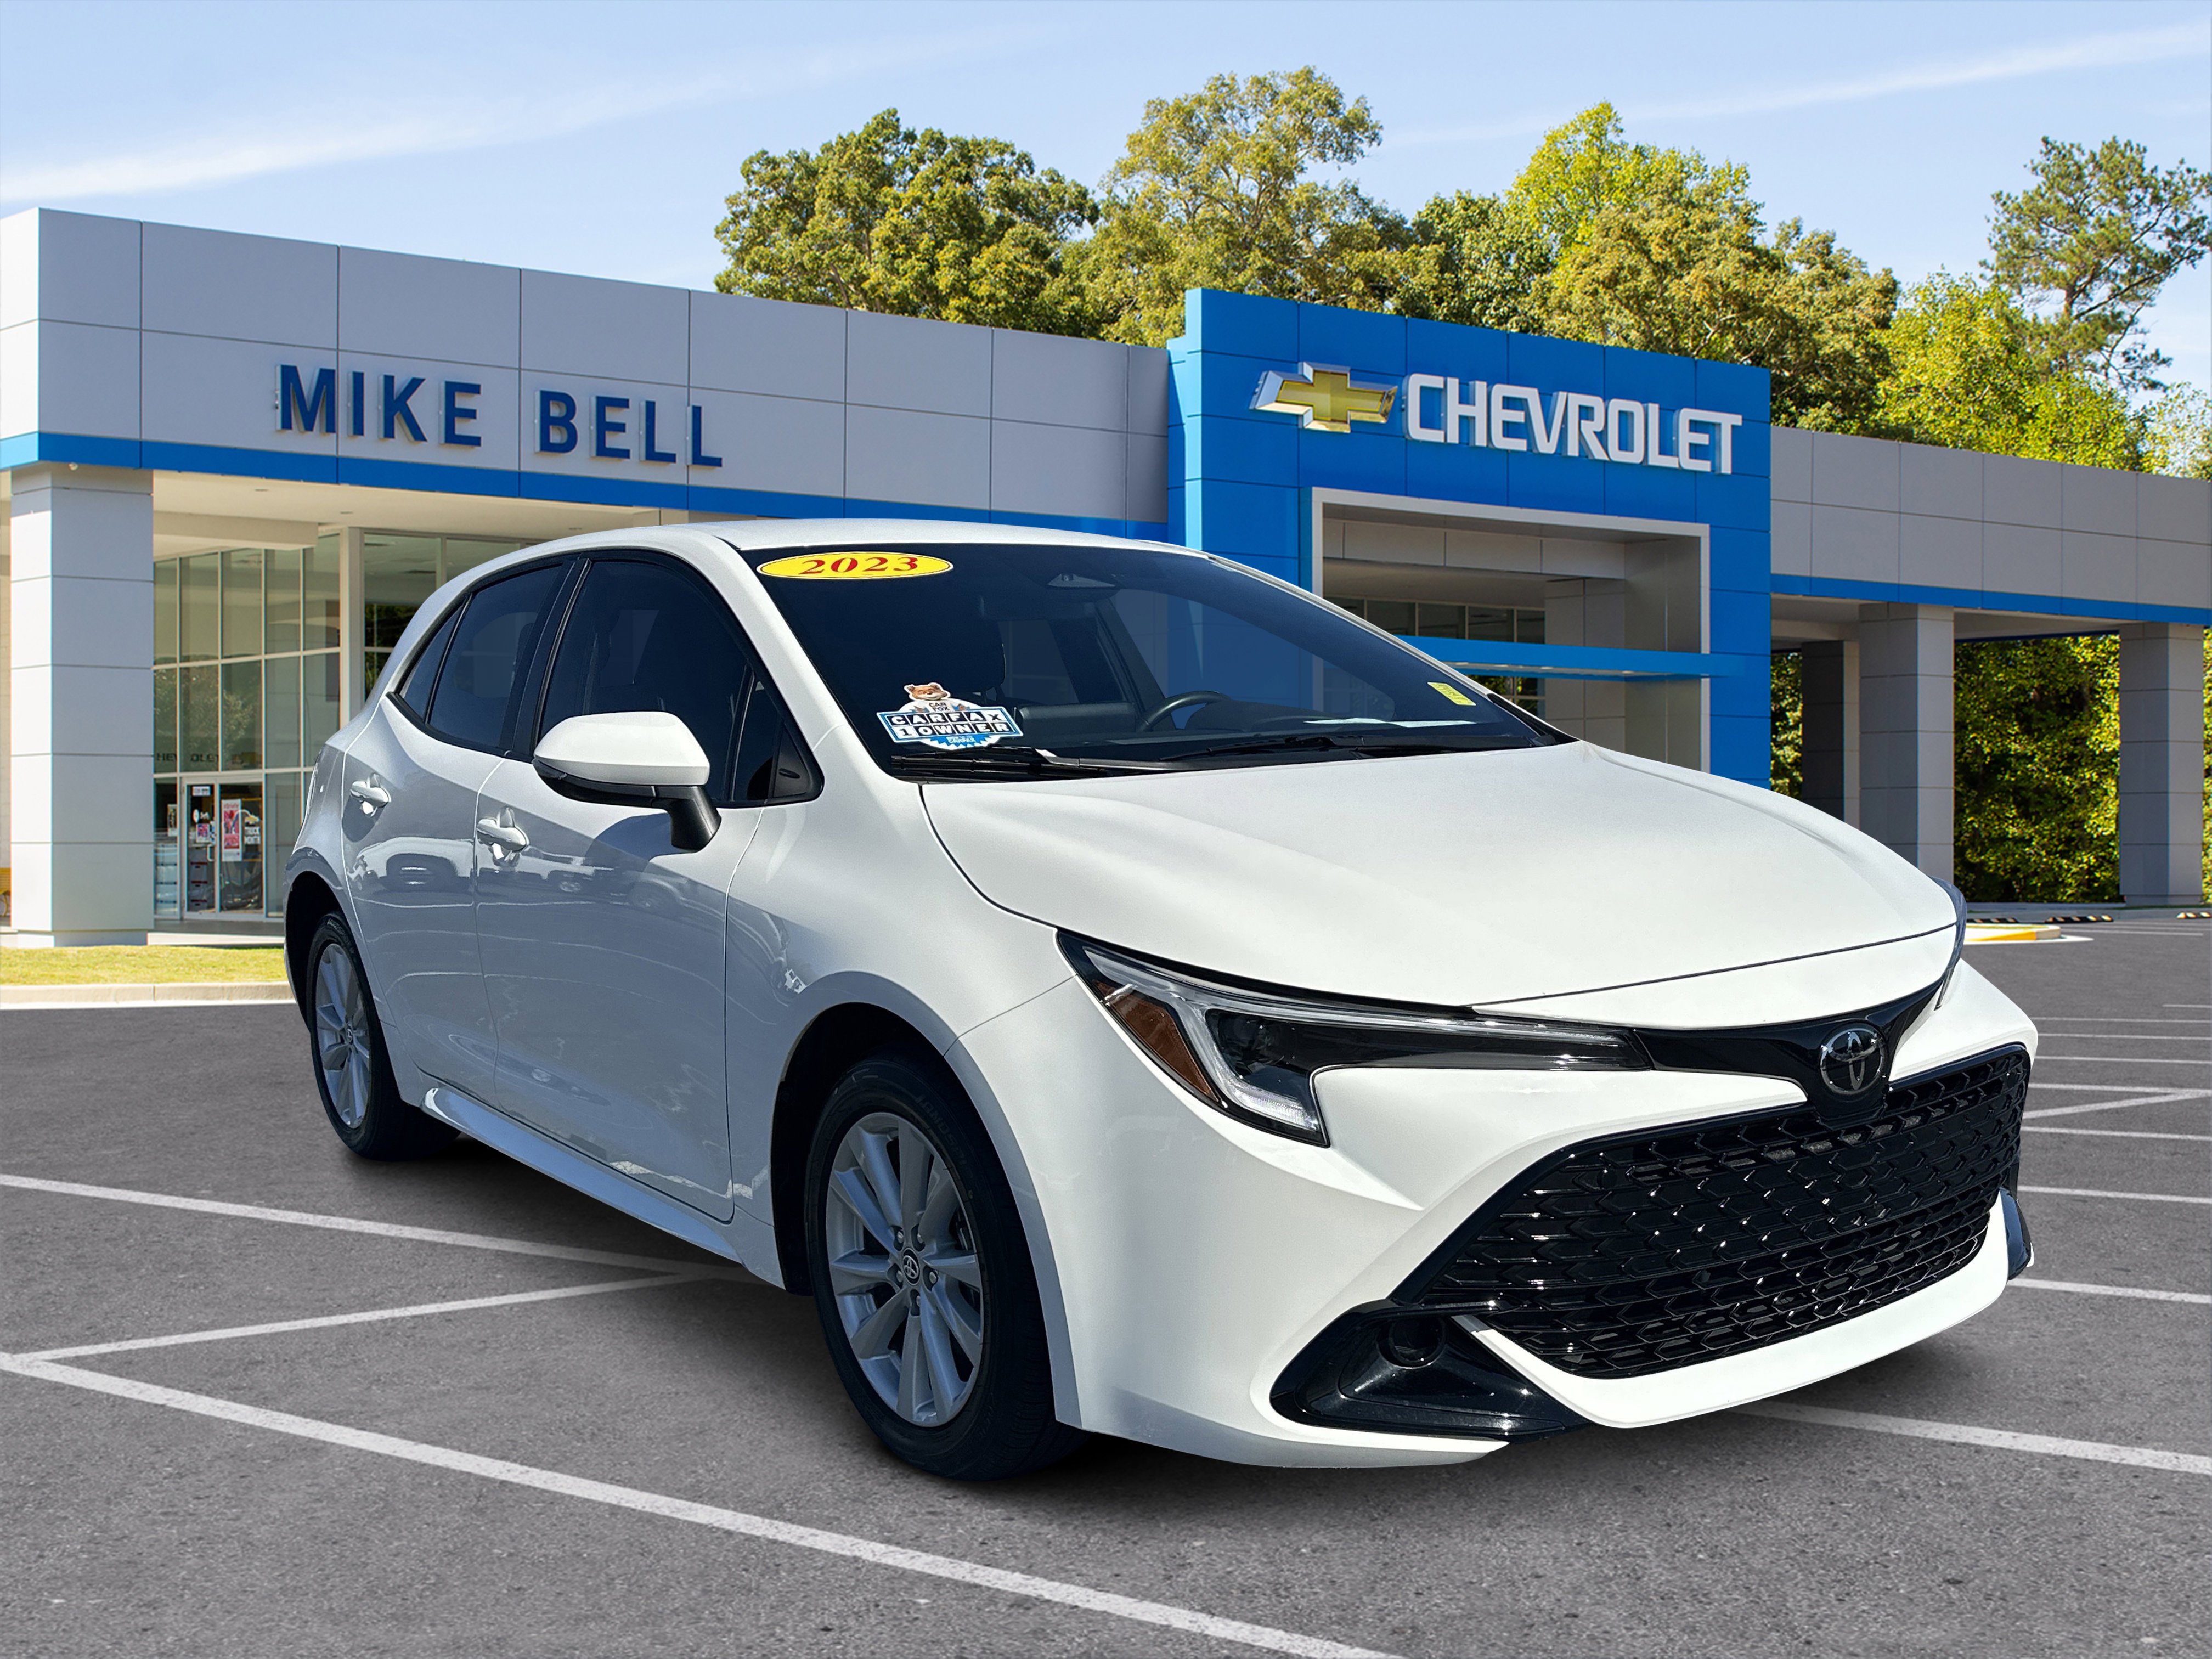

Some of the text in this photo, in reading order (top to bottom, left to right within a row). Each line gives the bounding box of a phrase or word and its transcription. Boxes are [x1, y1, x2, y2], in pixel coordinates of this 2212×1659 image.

[275, 364, 723, 468] MIKE BELL
[1402, 373, 1742, 475] CHEVROLET
[798, 556, 918, 575] 2023
[890, 712, 1003, 725] CARFAX
[898, 722, 1011, 737] 1 OWNER
